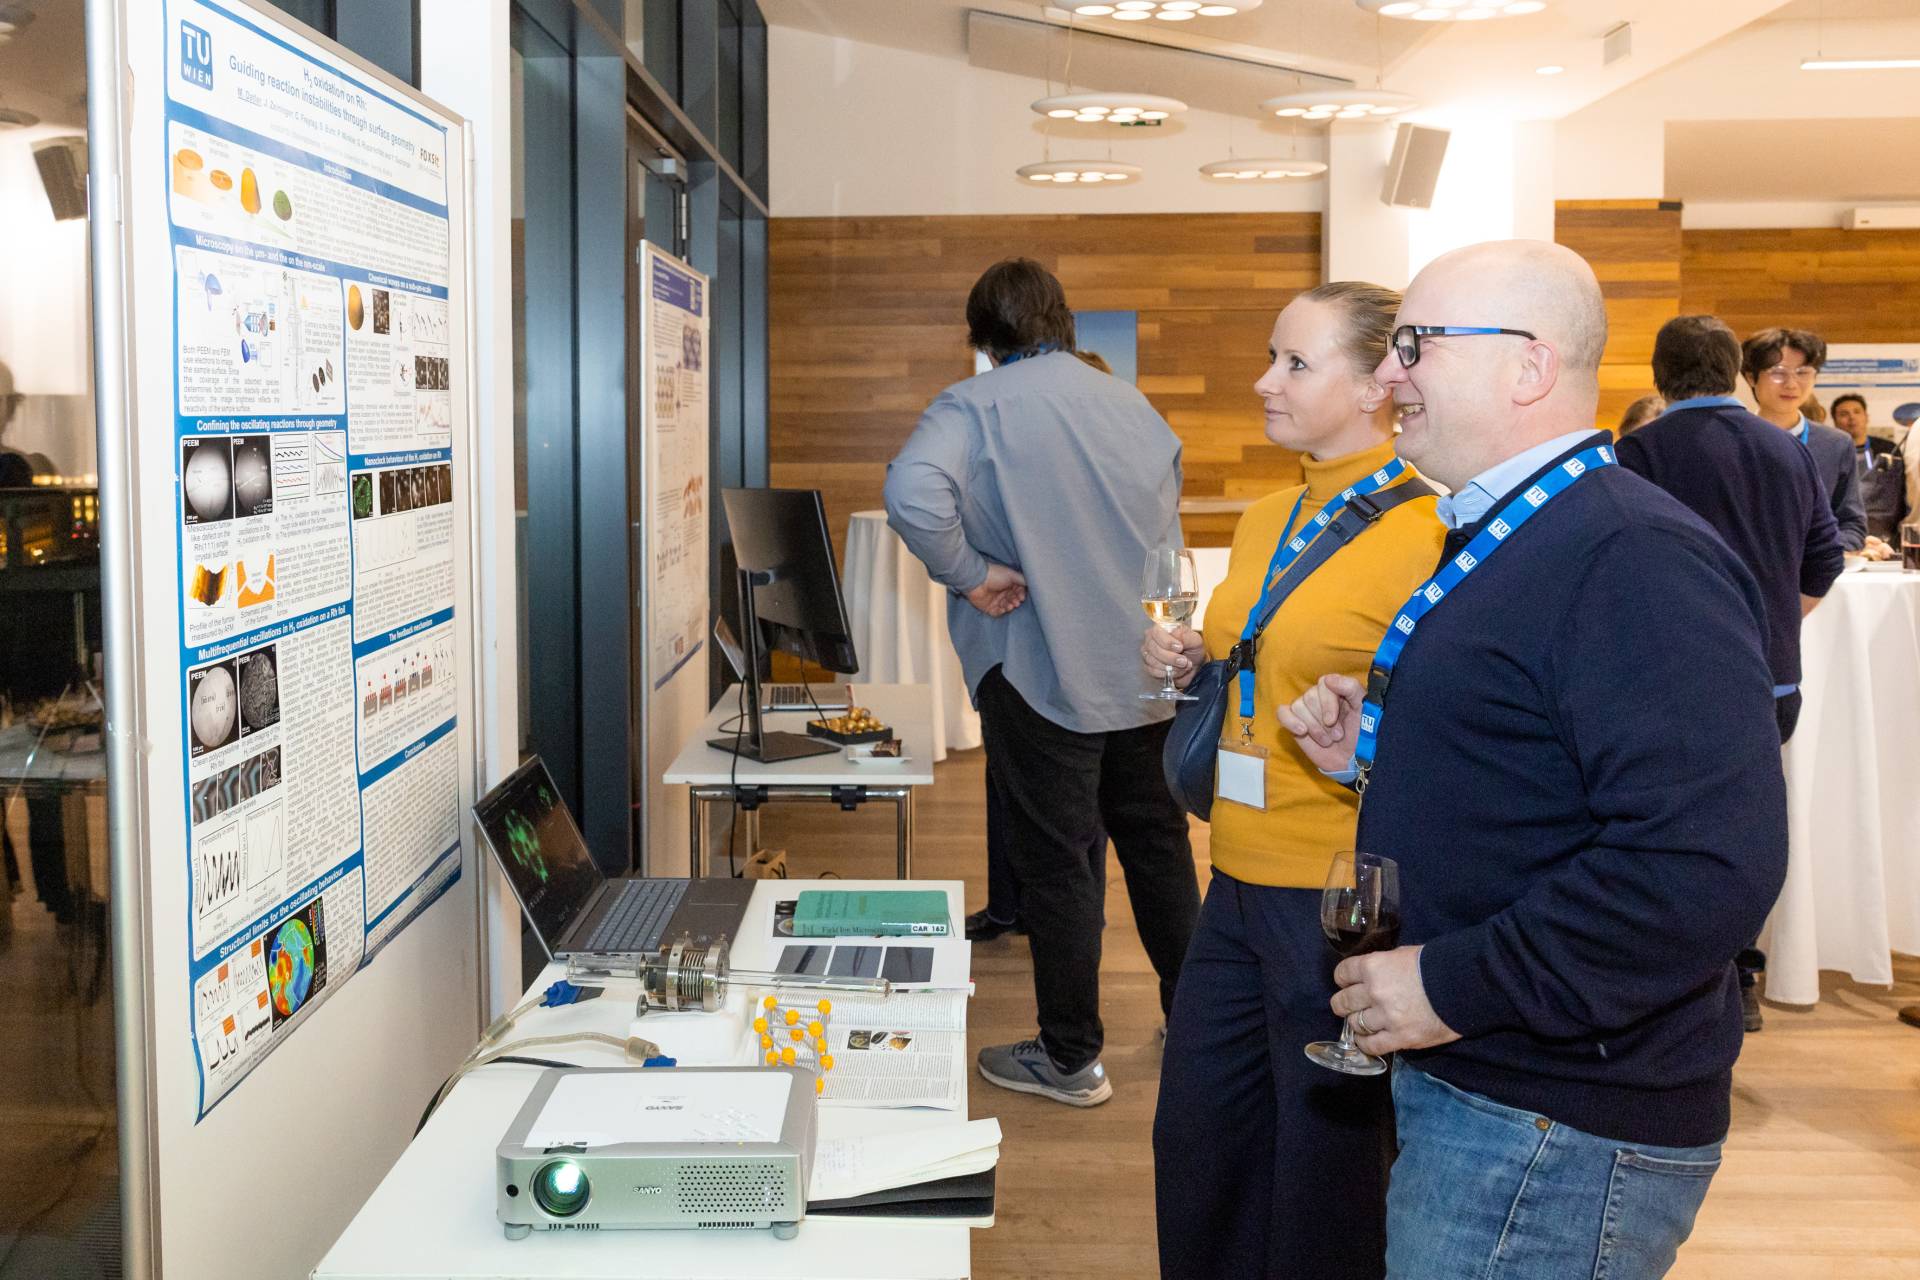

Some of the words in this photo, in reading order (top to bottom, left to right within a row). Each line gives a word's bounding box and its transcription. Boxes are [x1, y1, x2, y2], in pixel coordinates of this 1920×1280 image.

[182, 25, 210, 65] TU
[183, 64, 211, 85] WIEN
[314, 76, 345, 100] oxidation
[345, 92, 355, 104] on
[229, 55, 266, 86] Guiding
[267, 75, 300, 98] reaction
[301, 89, 342, 118] instabilities
[343, 108, 368, 131] through
[368, 123, 390, 141] surface
[391, 132, 416, 153] geometry
[195, 234, 233, 254] Microscopy
[268, 249, 279, 262] and
[196, 419, 230, 432] Confining
[230, 419, 240, 430] the
[240, 418, 270, 432] oscillating
[270, 419, 295, 429] reactions
[295, 418, 315, 430] through
[316, 418, 337, 430] geometry
[183, 439, 199, 447] PEEM
[233, 438, 245, 446] PEEM
[1570, 459, 1585, 472] TU
[1378, 469, 1389, 482] TU
[1531, 486, 1546, 501] TU
[1319, 511, 1330, 523] TU
[1494, 519, 1509, 534] TU
[1294, 537, 1306, 549] TU
[1461, 552, 1475, 567] TU
[1430, 584, 1442, 598] TU
[1400, 616, 1414, 630] TU
[198, 636, 249, 662] Multifrequential
[249, 629, 282, 644] oscillations
[296, 615, 319, 630] oxidation
[330, 606, 338, 617] Rh
[338, 604, 346, 614] foil
[239, 655, 250, 665] PEEM
[191, 671, 207, 681] PEEM
[1363, 715, 1373, 726] TU
[219, 930, 252, 959] Structural
[252, 919, 269, 936] limits
[269, 912, 279, 922] for
[279, 904, 289, 916] the
[289, 885, 318, 908] oscillating
[318, 866, 344, 890] behaviour
[633, 1186, 662, 1195] SANYO
